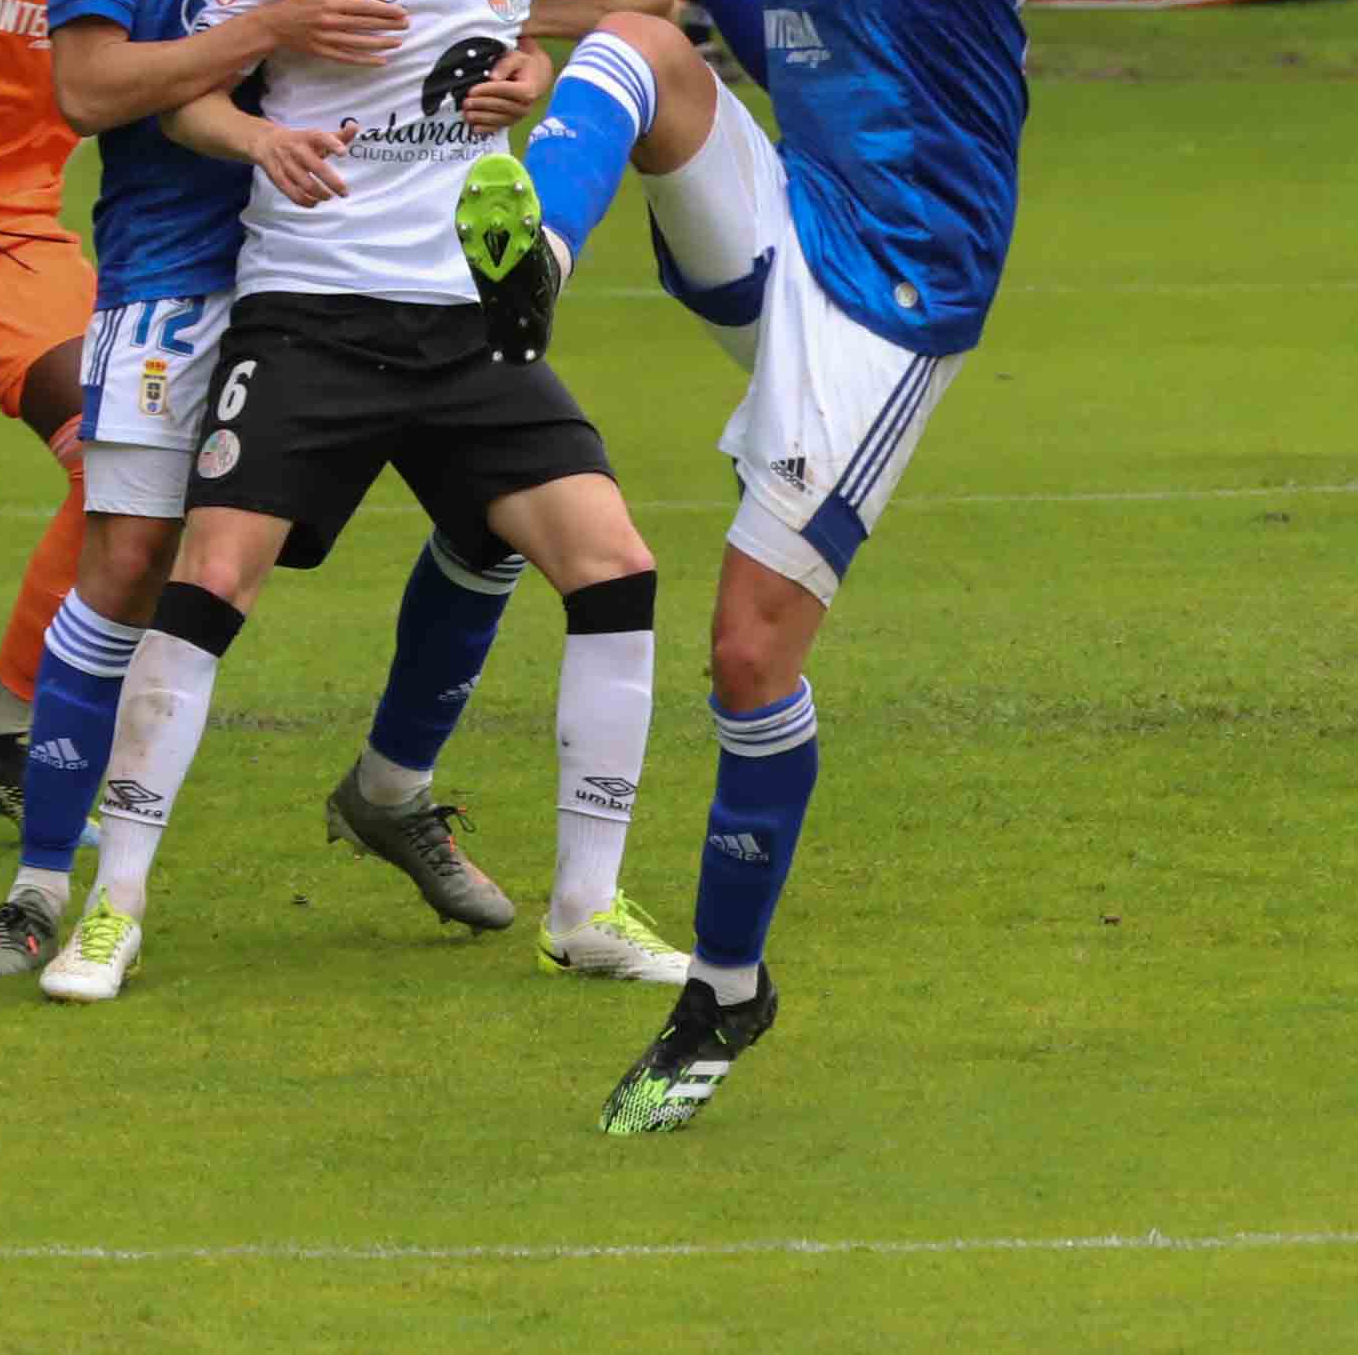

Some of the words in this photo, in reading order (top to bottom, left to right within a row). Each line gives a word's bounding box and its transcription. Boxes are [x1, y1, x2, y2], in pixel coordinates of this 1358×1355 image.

[348, 143, 417, 163] CIUDAD
[129, 297, 207, 358] 12
[217, 359, 258, 422] 6
